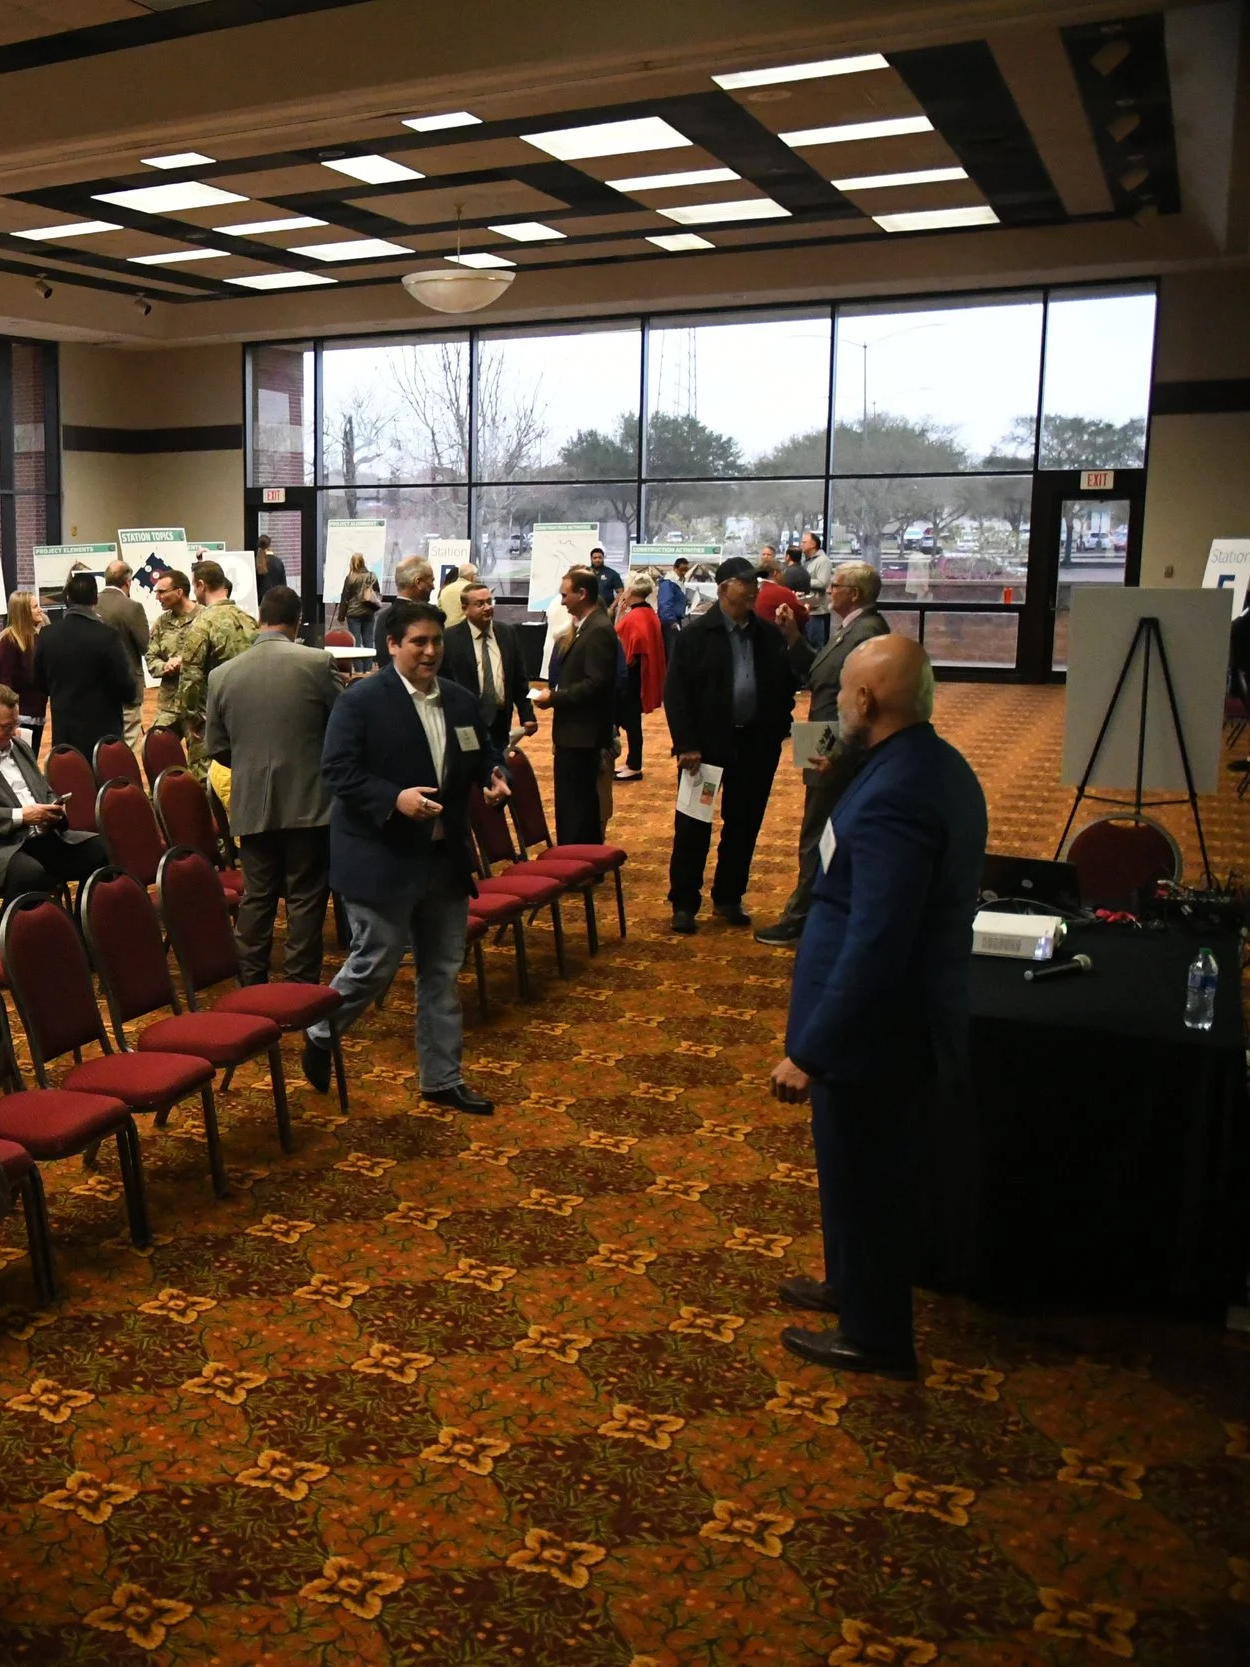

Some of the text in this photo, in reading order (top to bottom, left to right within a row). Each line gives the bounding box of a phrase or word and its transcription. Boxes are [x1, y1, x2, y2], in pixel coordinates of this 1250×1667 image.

[1087, 473, 1108, 487] EXIT
[267, 490, 280, 501] EXIT
[121, 531, 174, 542] STATION TOPICS
[63, 546, 94, 554] ELEMENTS
[431, 545, 468, 557] Station
